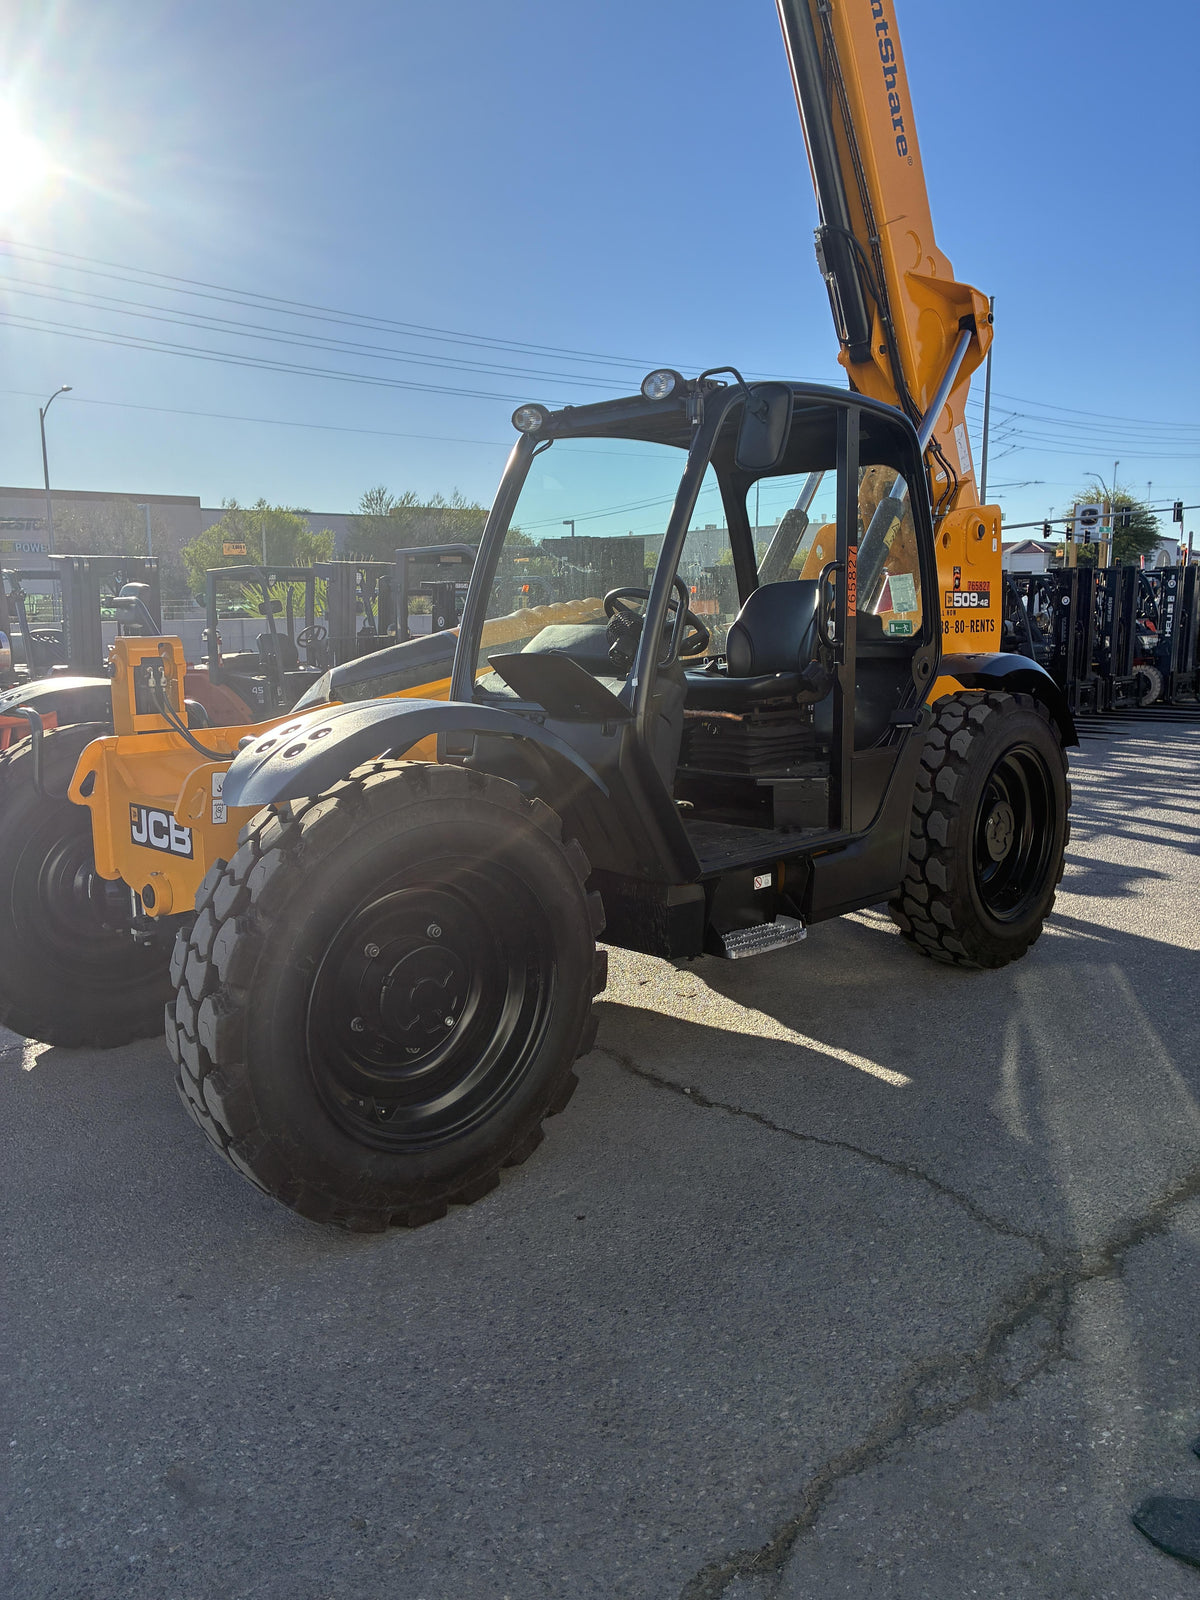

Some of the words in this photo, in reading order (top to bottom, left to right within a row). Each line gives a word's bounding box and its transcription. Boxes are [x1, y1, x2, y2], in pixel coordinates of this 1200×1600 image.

[847, 547, 857, 613] 765827
[967, 581, 990, 591] 765827
[132, 809, 191, 854] JCB
